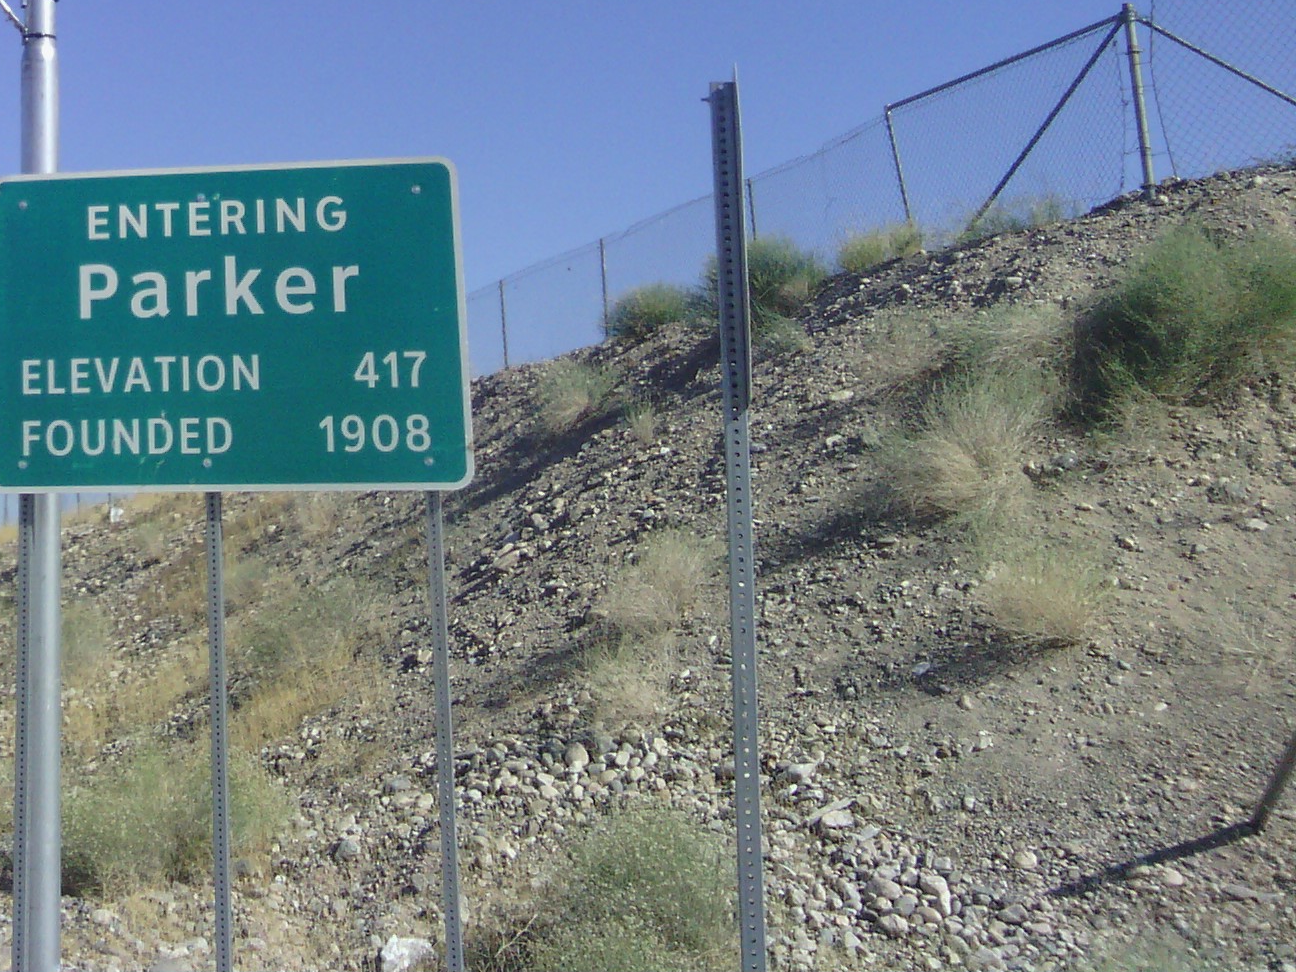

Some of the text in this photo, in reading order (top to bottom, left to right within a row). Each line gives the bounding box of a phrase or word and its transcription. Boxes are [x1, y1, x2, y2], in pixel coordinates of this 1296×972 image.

[87, 195, 347, 240] ENTERING
[78, 255, 360, 320] Parker
[22, 350, 427, 395] ELEVATION 417
[22, 414, 432, 456] FOUNDED 1908
